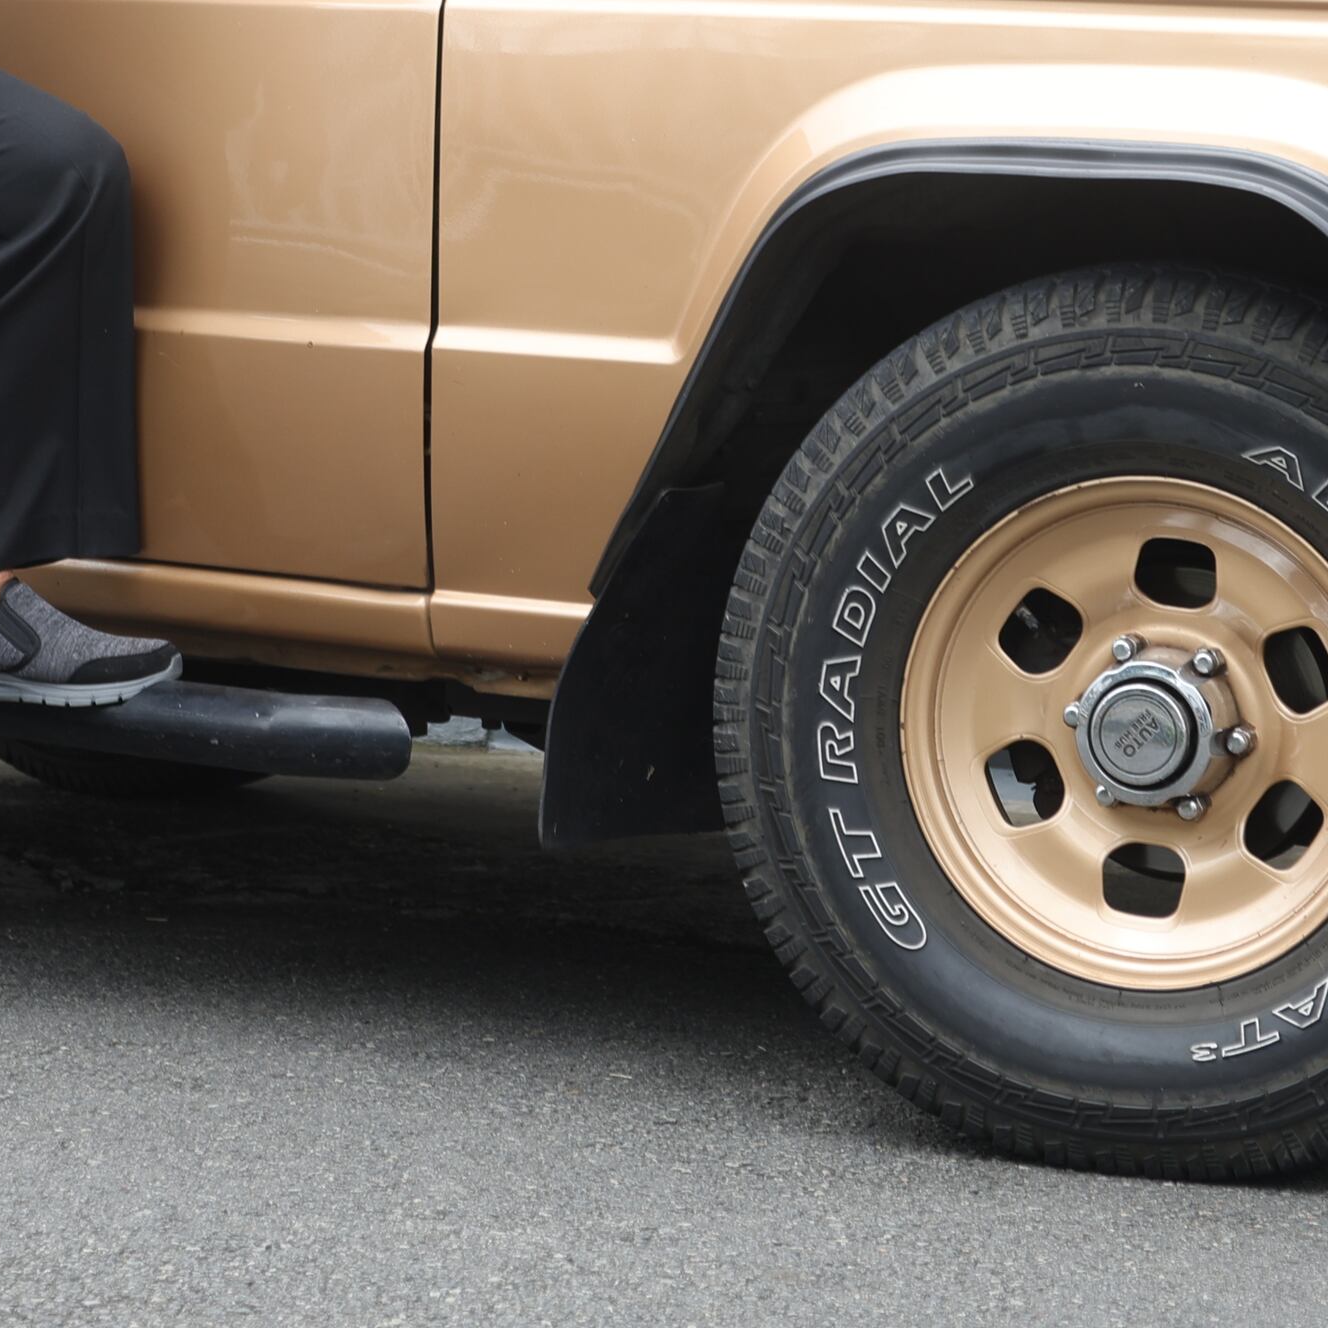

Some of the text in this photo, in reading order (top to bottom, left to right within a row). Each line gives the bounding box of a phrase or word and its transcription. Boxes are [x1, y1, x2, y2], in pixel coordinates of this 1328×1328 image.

[815, 465, 976, 952] GT RADIAL
[1123, 717, 1159, 757] AUTO
